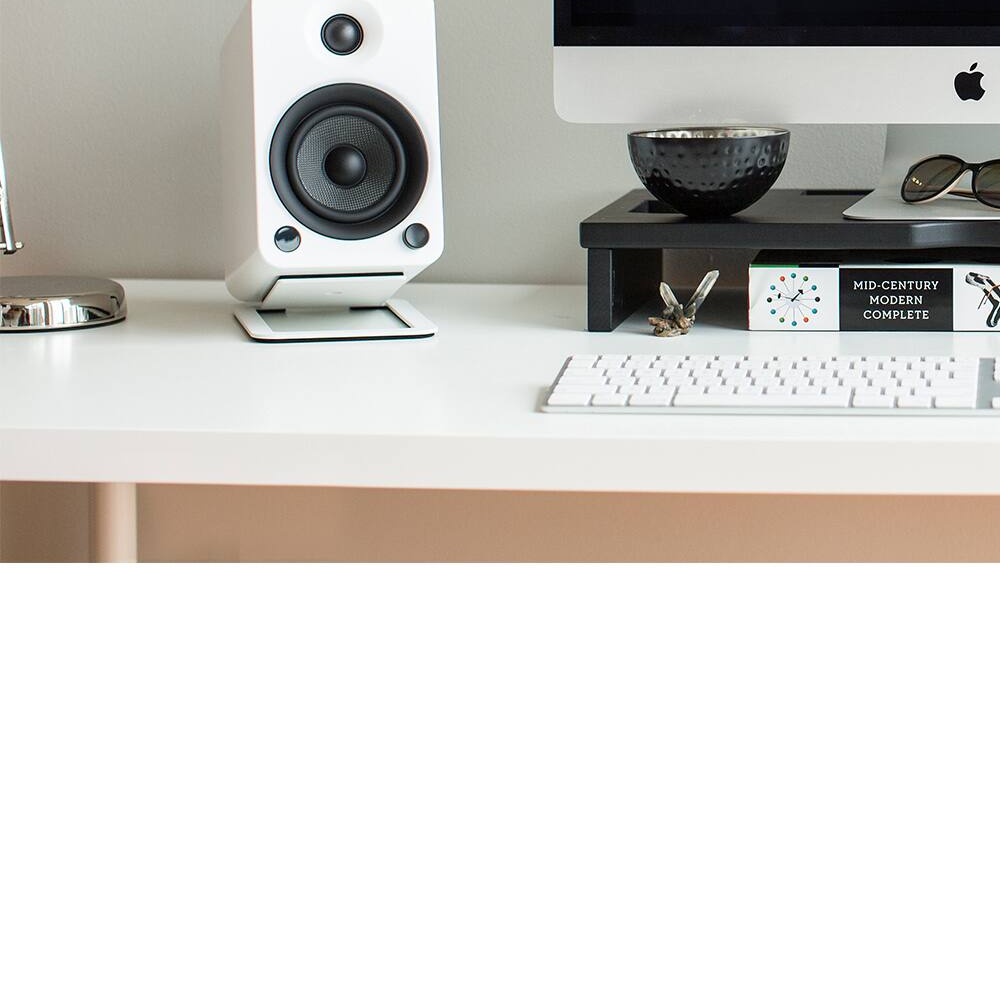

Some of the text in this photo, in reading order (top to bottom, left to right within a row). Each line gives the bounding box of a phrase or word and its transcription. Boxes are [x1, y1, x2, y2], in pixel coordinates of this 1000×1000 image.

[853, 280, 939, 290] MID-CENTURY
[869, 295, 923, 305] MODERN
[863, 310, 930, 320] COMPLETE
